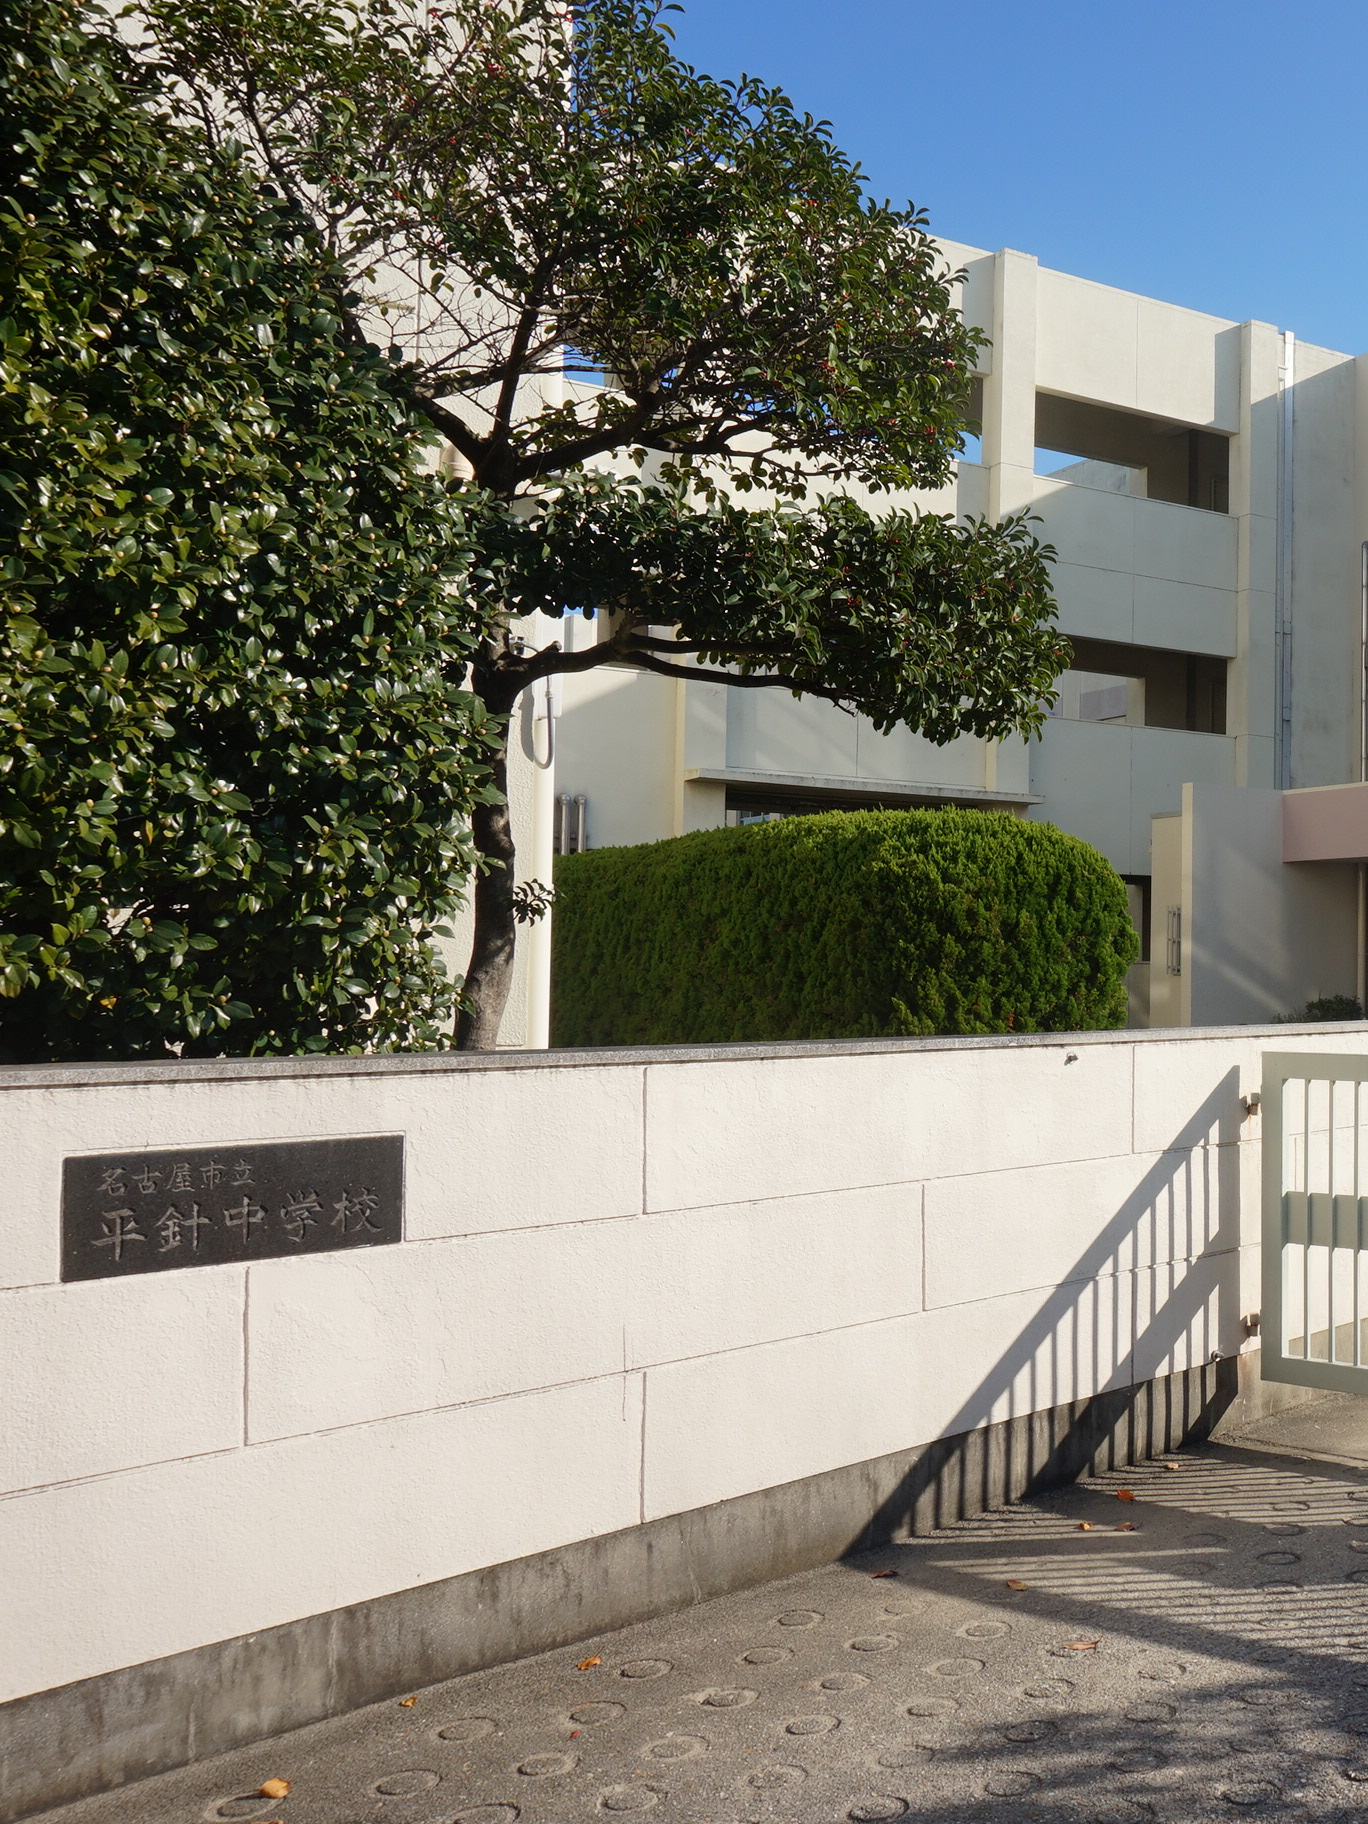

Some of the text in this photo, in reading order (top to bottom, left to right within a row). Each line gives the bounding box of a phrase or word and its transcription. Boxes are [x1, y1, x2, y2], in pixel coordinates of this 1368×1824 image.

[97, 1159, 256, 1197] 名古屋市立
[91, 1187, 384, 1262] 平針中学校
